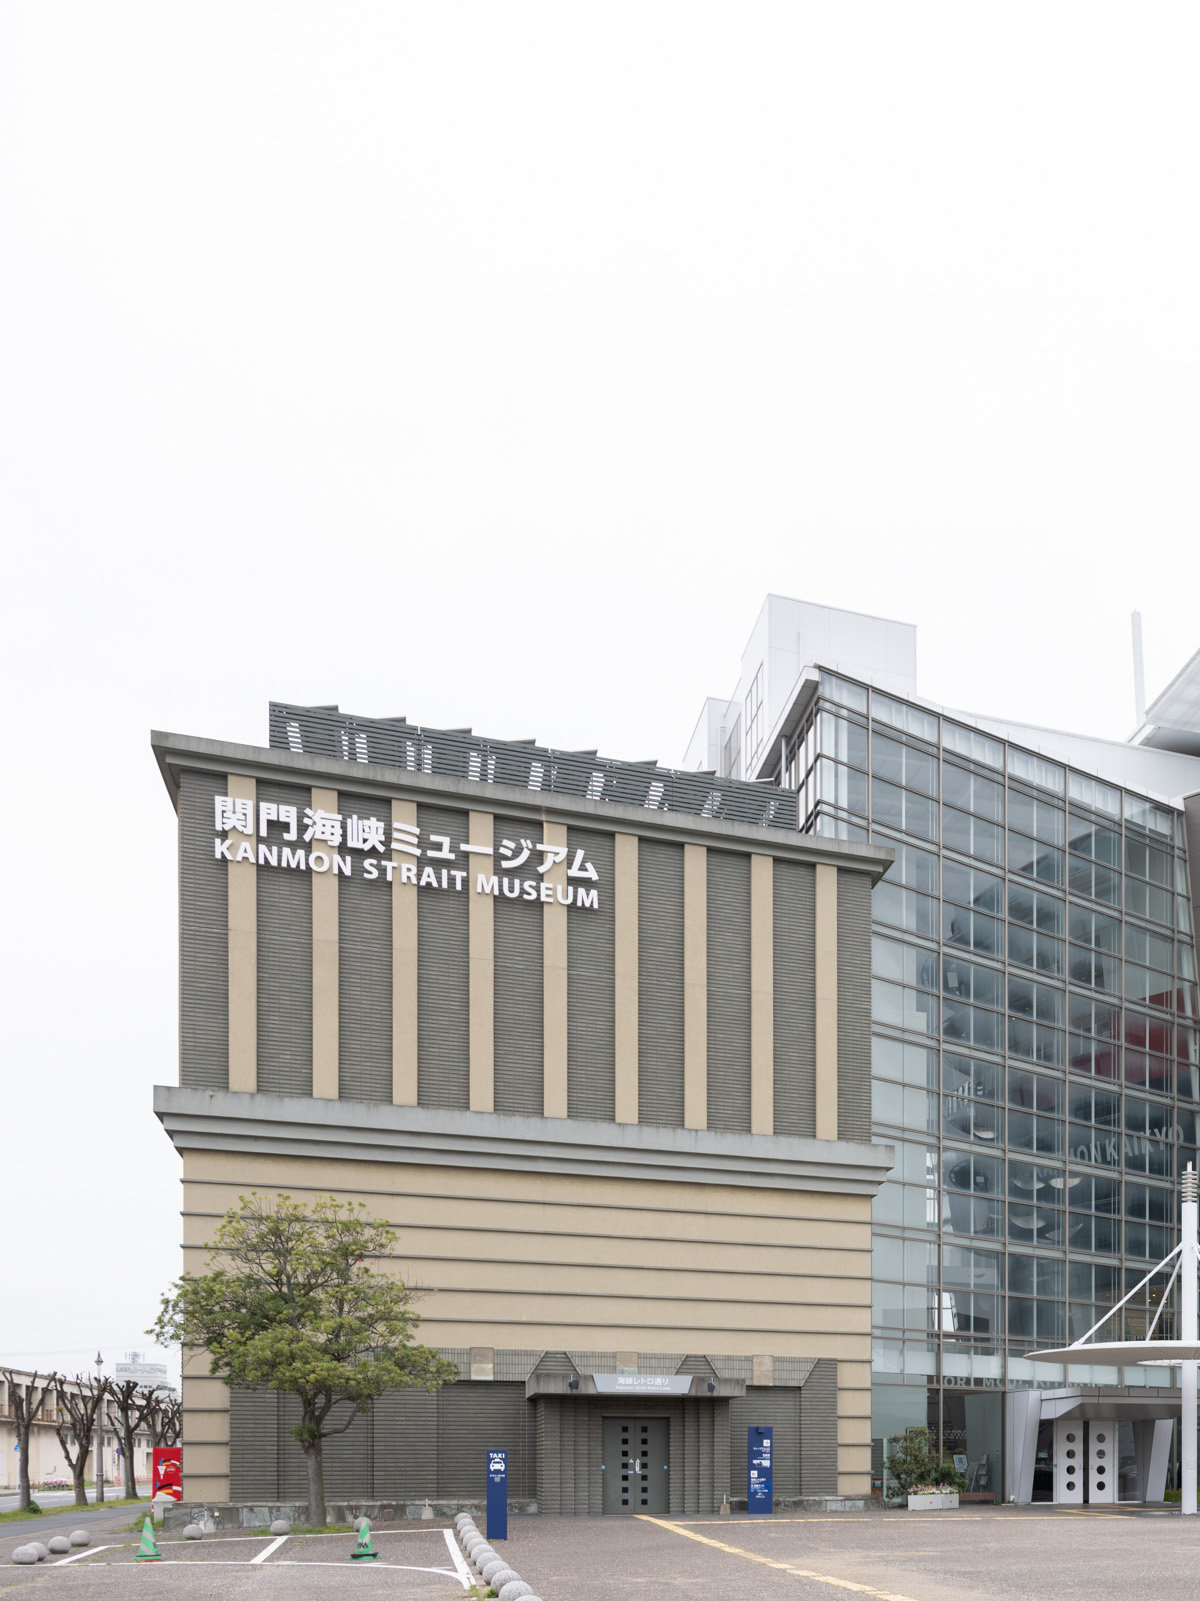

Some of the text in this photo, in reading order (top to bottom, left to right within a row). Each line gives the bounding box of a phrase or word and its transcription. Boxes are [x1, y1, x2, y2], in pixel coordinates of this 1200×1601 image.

[213, 795, 600, 881] 関門海峡ミュージアム
[213, 837, 600, 909] KANMON STRAIT MUSEUM
